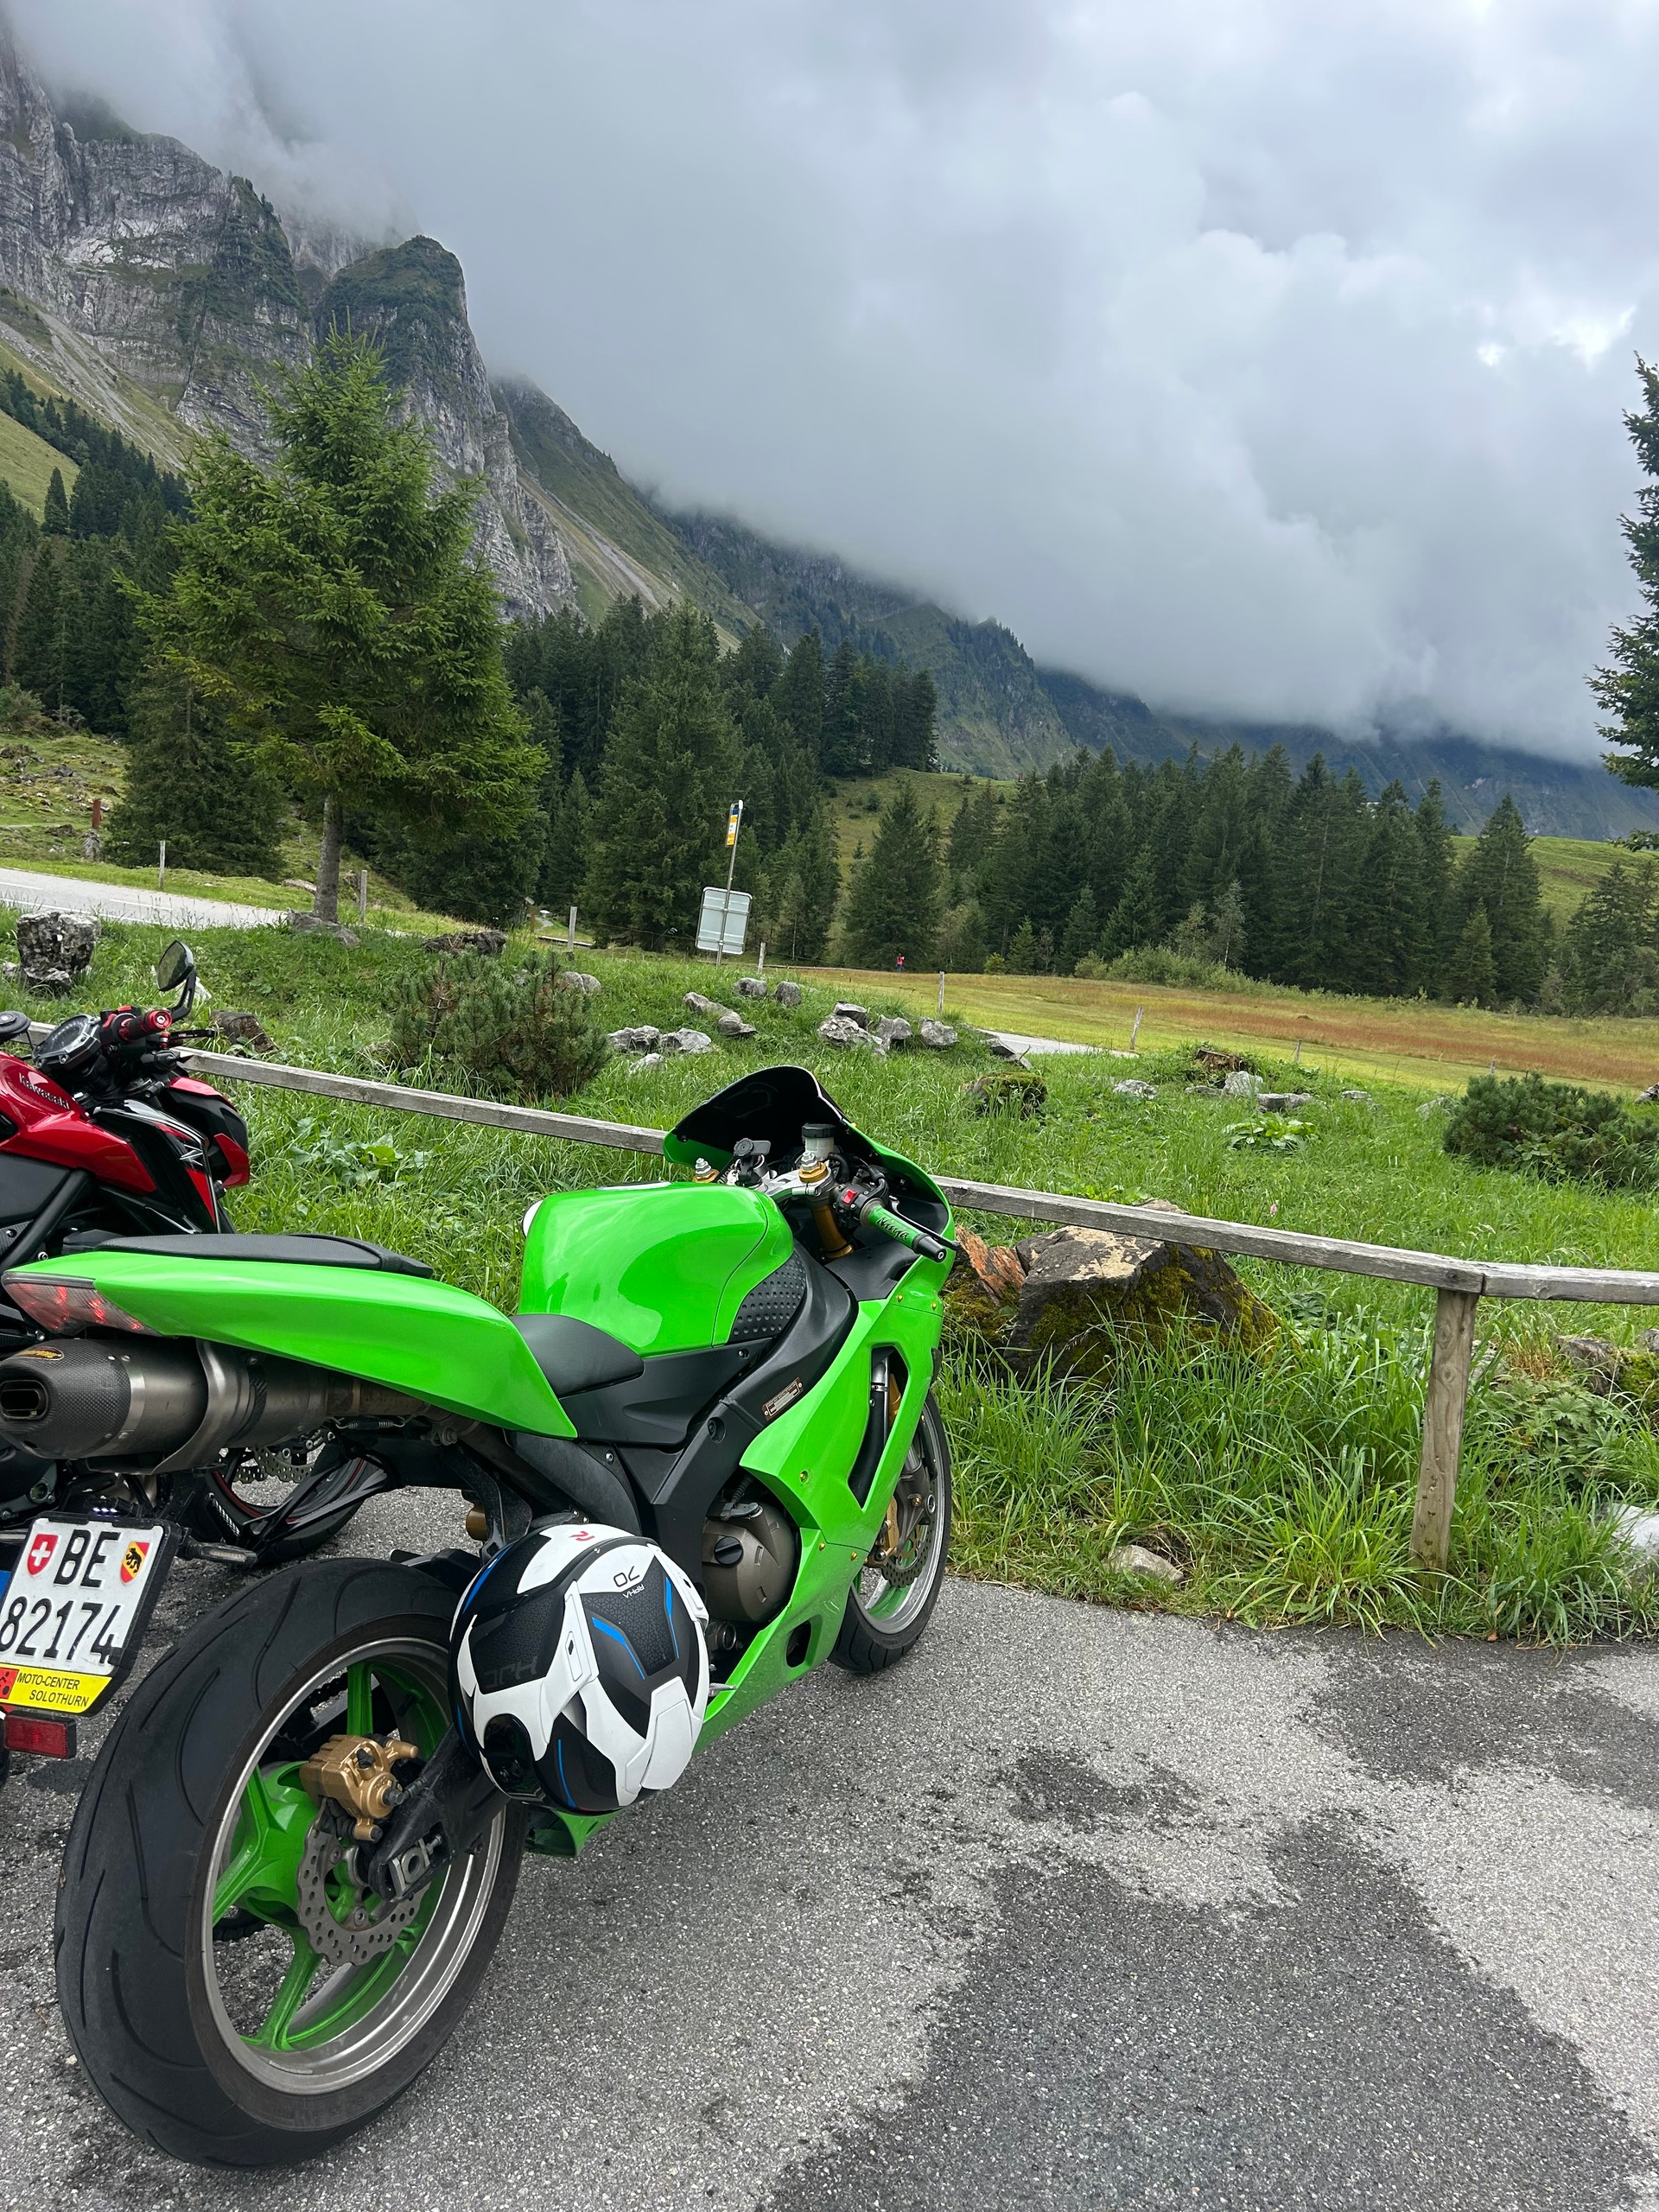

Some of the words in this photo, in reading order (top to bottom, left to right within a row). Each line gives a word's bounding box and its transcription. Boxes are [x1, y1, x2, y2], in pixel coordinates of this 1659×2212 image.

[19, 1072, 70, 1110] Kawasaki
[876, 1217, 910, 1240] Ninja
[54, 1529, 121, 1587] BE
[613, 1565, 640, 1587] 70
[0, 1596, 121, 1665] 82174
[17, 1672, 80, 1690] MOTO-CENTER
[29, 1689, 90, 1707] SOLOTHURN
